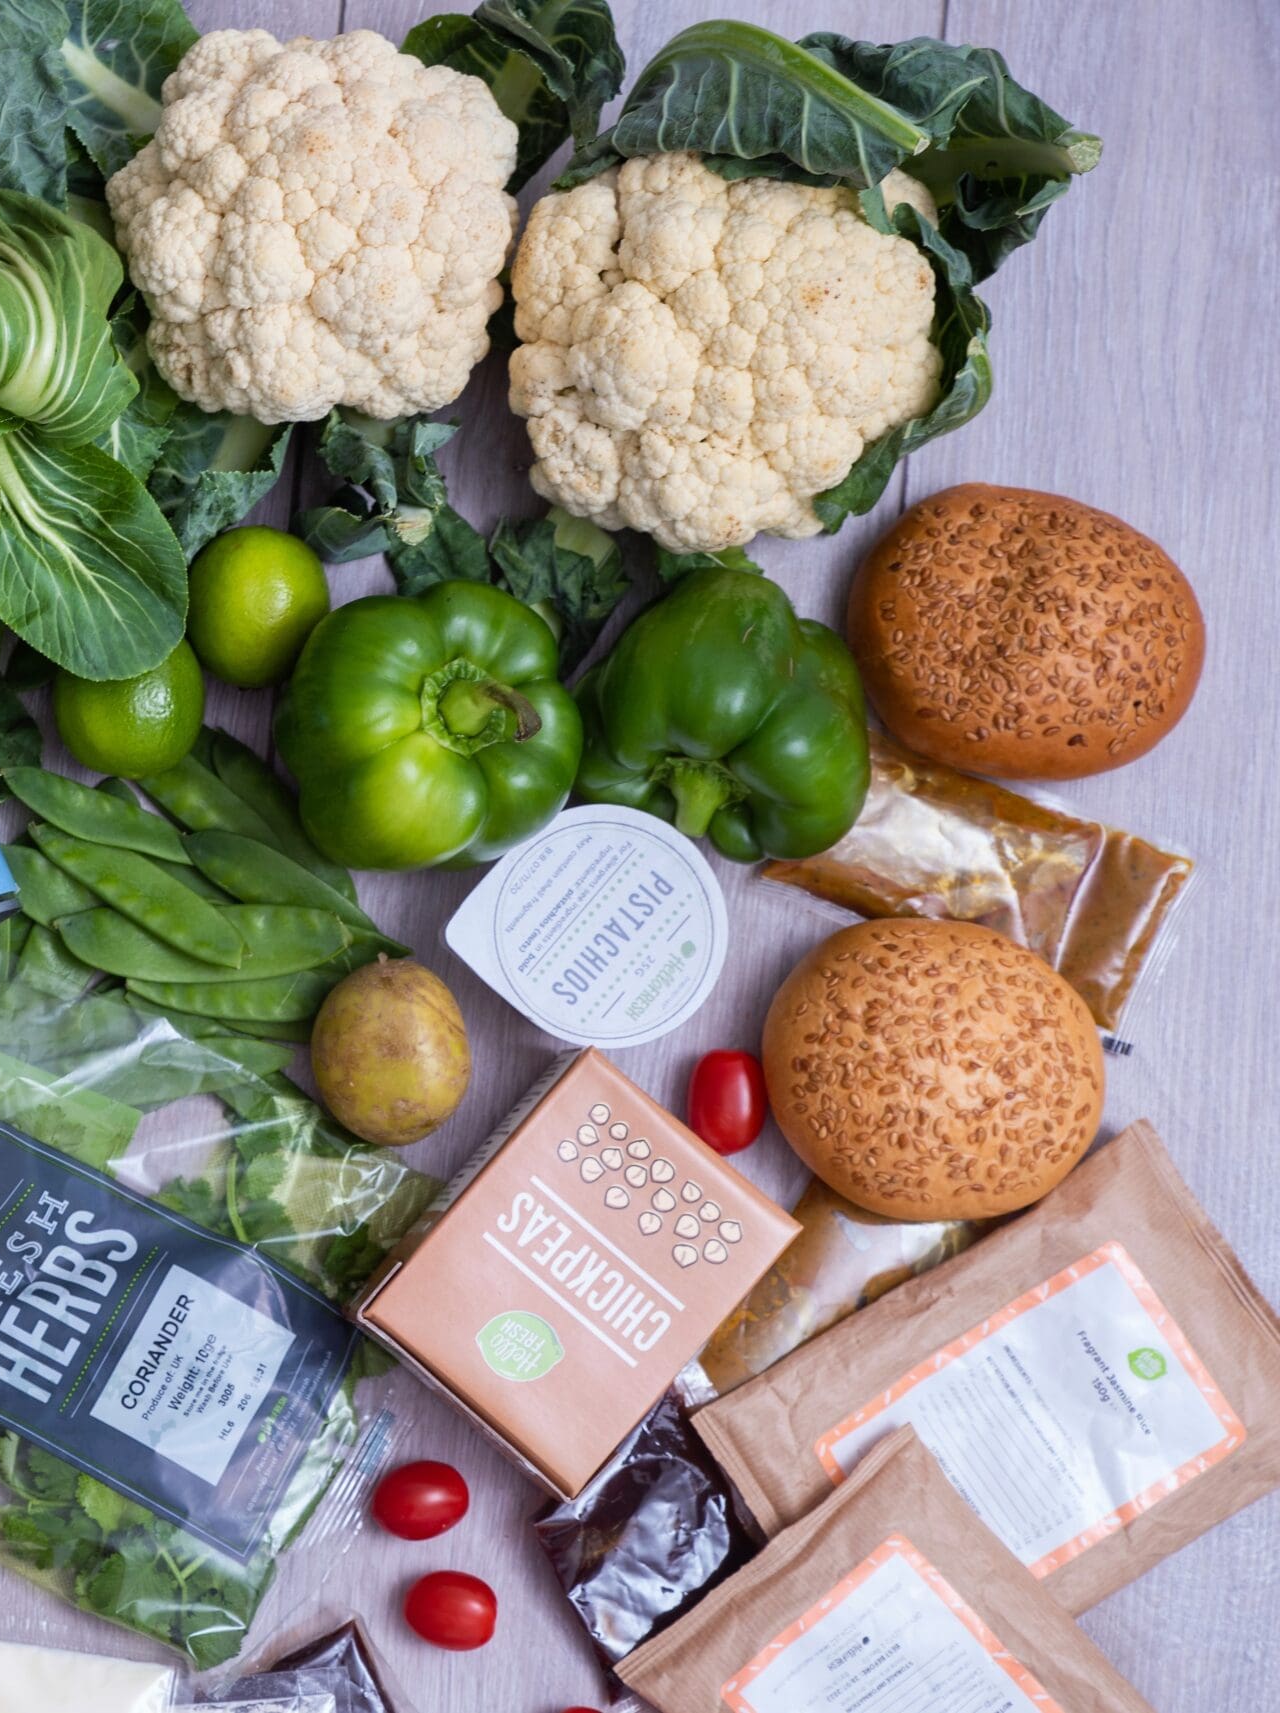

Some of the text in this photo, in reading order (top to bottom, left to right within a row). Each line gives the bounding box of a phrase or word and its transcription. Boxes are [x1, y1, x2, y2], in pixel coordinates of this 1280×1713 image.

[551, 849, 579, 880] contain
[616, 839, 632, 856] For
[586, 853, 620, 889] allergens
[502, 894, 539, 934] fragments
[537, 888, 576, 929] pistachios
[539, 900, 580, 944] ingredients
[516, 927, 542, 954] (nuts)
[552, 869, 674, 1006] PISTACHIOS
[516, 951, 536, 973] bold
[634, 953, 656, 978] 25G
[496, 1191, 671, 1353] CHICKPEAS
[121, 1293, 195, 1410] CORIANDER
[489, 1333, 543, 1374] Hello
[499, 1317, 548, 1354] FRESH
[141, 1382, 169, 1422] Produce
[171, 1353, 185, 1371] UK
[168, 1365, 202, 1412] Weight:
[183, 1400, 196, 1418] Store
[194, 1386, 205, 1399] me
[206, 1365, 216, 1379] the
[195, 1392, 212, 1415] Wash
[208, 1368, 226, 1393] Before
[1076, 1330, 1111, 1382] Fragrant
[1105, 1374, 1138, 1417] Jasmine
[1133, 1410, 1152, 1436] Rice
[1089, 1376, 1111, 1405] 150g
